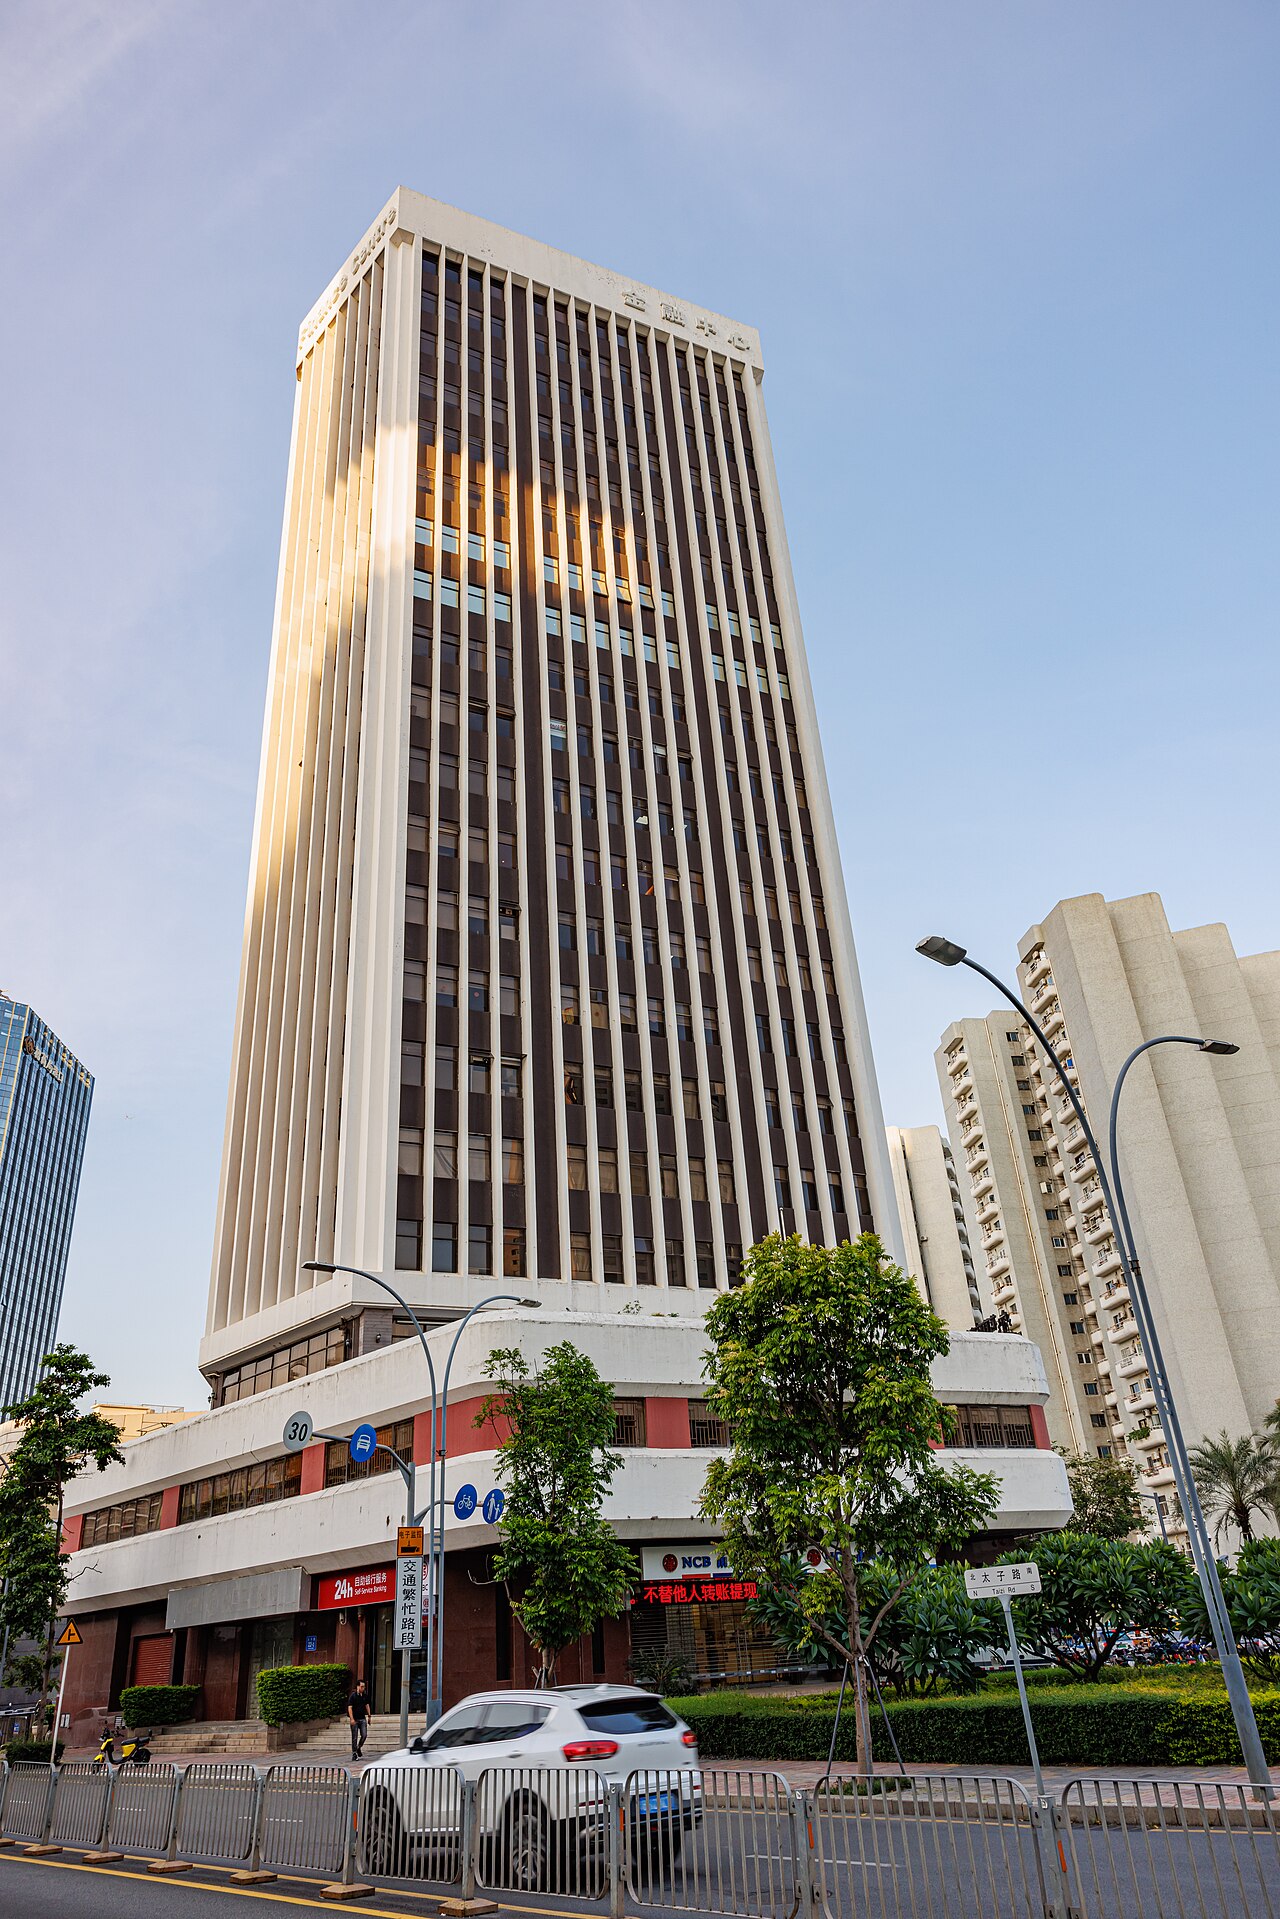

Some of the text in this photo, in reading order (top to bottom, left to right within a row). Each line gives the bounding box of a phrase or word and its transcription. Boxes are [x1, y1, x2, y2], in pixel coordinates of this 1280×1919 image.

[621, 290, 750, 351] 金融中心
[288, 1421, 308, 1441] 30
[399, 1530, 422, 1539] 电子监控
[681, 1556, 711, 1569] NCB
[354, 1572, 387, 1587] 自助银行服务
[982, 1568, 1021, 1583] 太子路
[334, 1579, 353, 1600] 24h
[354, 1585, 387, 1596] Self-Service Banking
[400, 1560, 417, 1645] 交通繁忙路段
